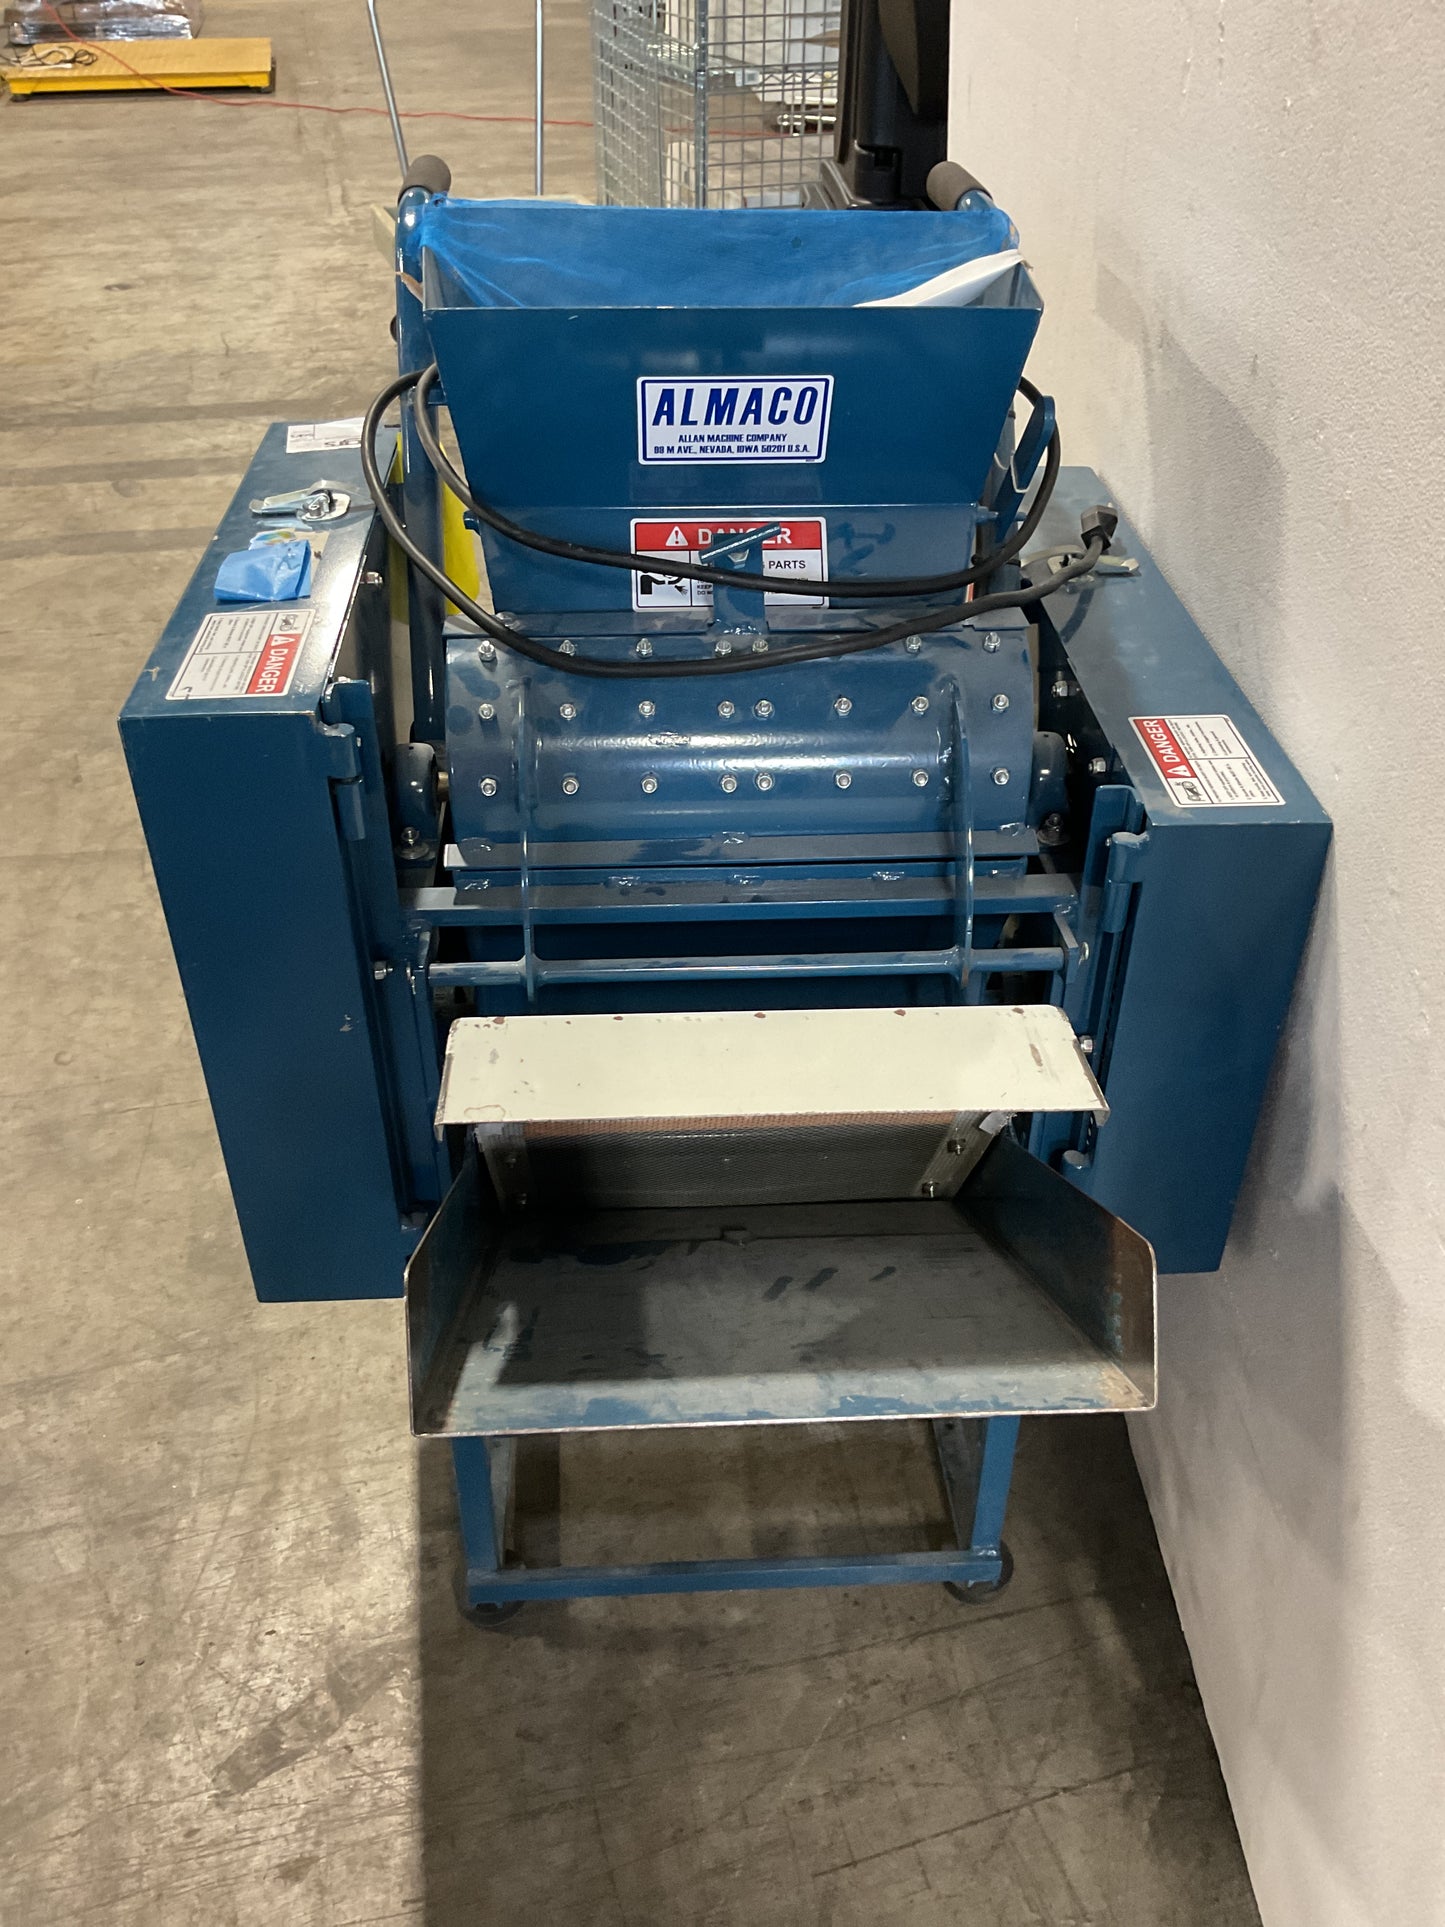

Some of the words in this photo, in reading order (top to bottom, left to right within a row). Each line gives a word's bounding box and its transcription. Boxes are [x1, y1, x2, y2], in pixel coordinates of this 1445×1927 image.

[652, 386, 818, 427] ALMACO
[667, 446, 675, 454] M
[736, 445, 759, 453] IOWA
[761, 444, 785, 453] 50201
[787, 444, 810, 453] U.S.A.
[678, 434, 705, 443] ALLAN
[707, 434, 744, 442] MACHINE
[746, 433, 788, 442] COMPANY
[768, 560, 806, 569] PARTS
[255, 648, 288, 693] DANGER
[1142, 720, 1181, 763] DANGER
